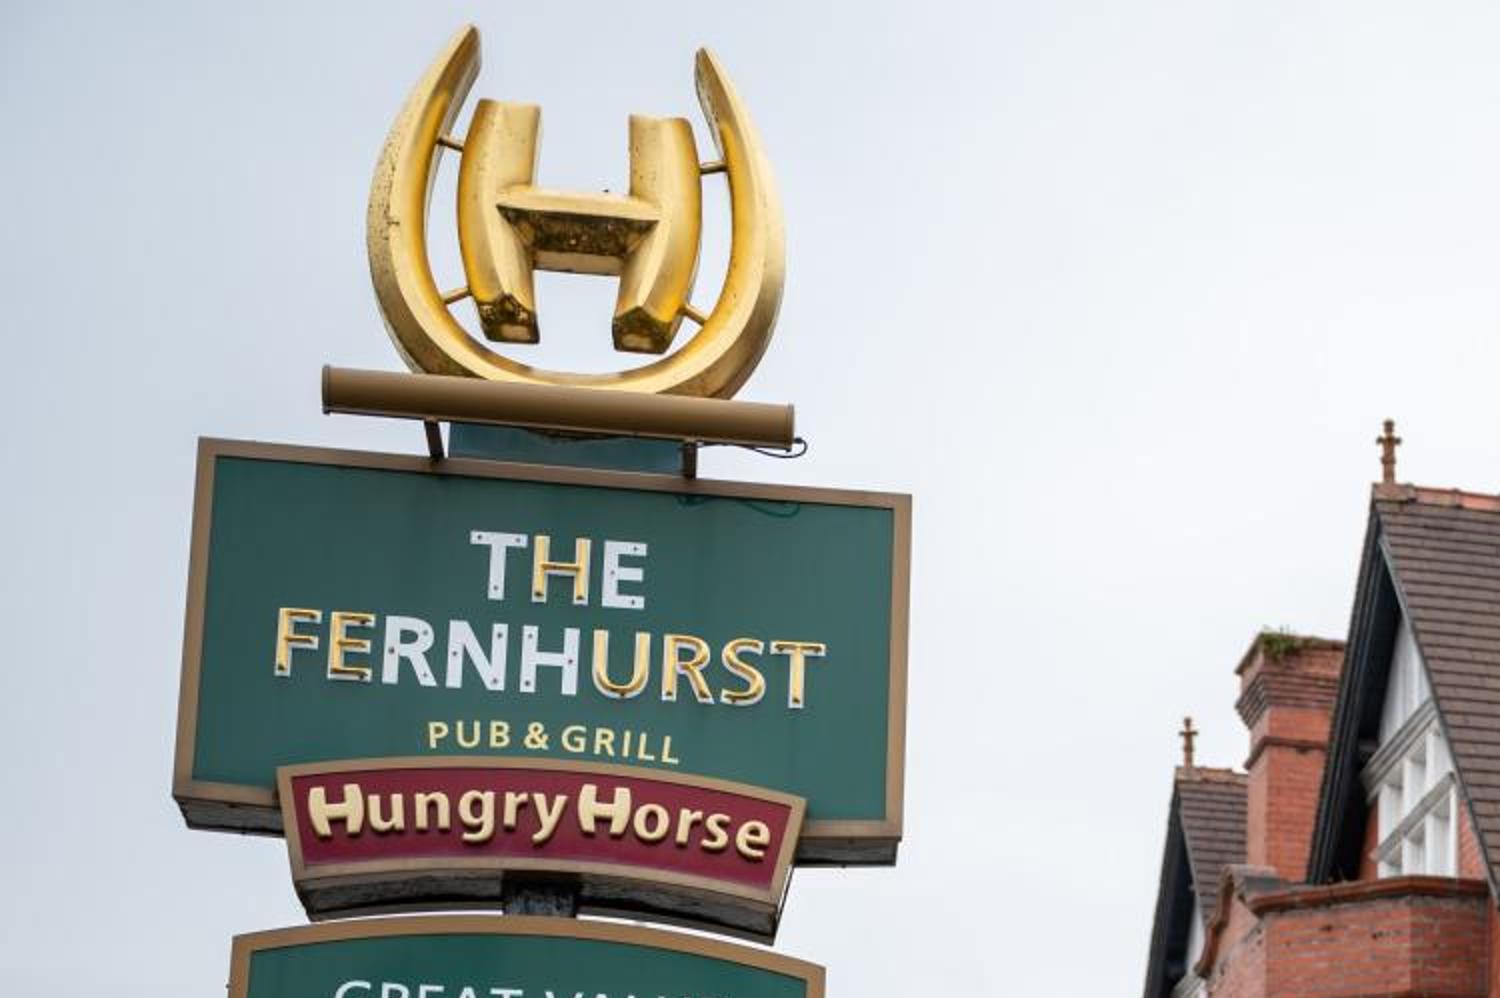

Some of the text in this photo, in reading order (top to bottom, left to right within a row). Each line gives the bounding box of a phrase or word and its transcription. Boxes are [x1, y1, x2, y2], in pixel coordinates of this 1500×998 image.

[470, 530, 648, 609] THE
[274, 607, 827, 709] FERNHURST
[428, 720, 680, 765] PUB & GRILL
[307, 783, 772, 861] Hungry Horse
